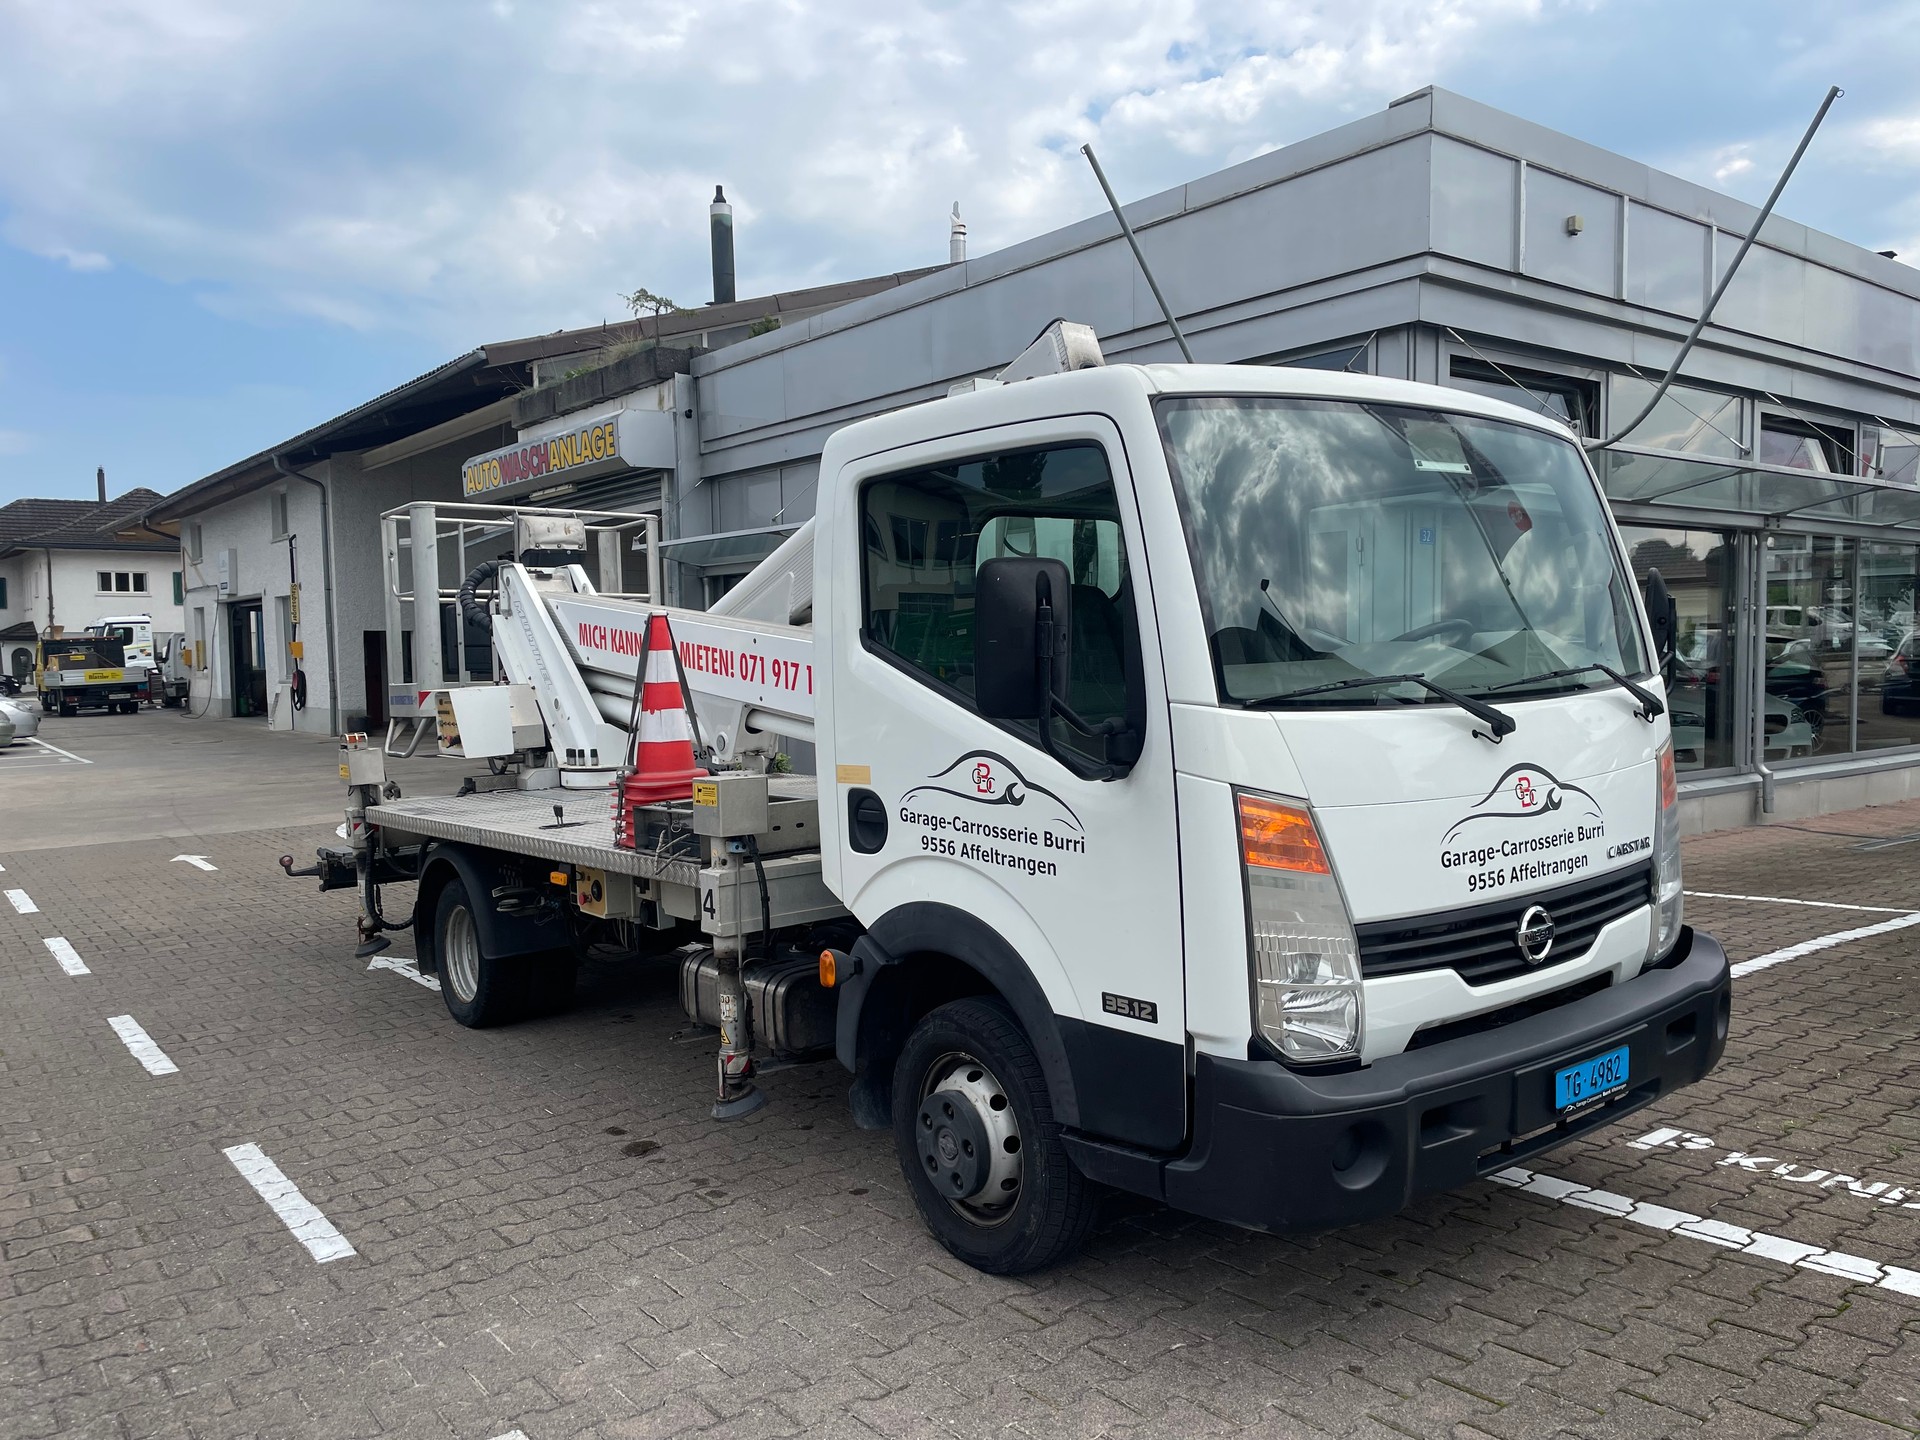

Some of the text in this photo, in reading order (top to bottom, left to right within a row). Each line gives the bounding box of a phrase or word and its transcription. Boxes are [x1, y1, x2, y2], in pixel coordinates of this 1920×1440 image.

[466, 422, 616, 494] AUTOWASCHANLAGE
[579, 622, 643, 657] MICH KANN
[680, 641, 735, 678] MIETEN!
[740, 653, 765, 685] 071
[772, 659, 799, 691] 917
[900, 807, 1085, 854] Garage-Carrosserie Burri
[1441, 821, 1605, 868] Garage-Carrosserie Burri
[1606, 836, 1651, 860] CABSTAR
[921, 835, 1057, 877] 9556 Affeltrangen
[1468, 854, 1588, 892] 9556 Affeltrangen
[703, 888, 716, 920] 4
[1524, 928, 1553, 943] NISSA
[1105, 995, 1153, 1020] 35.12
[1564, 1054, 1621, 1100] TG 4982
